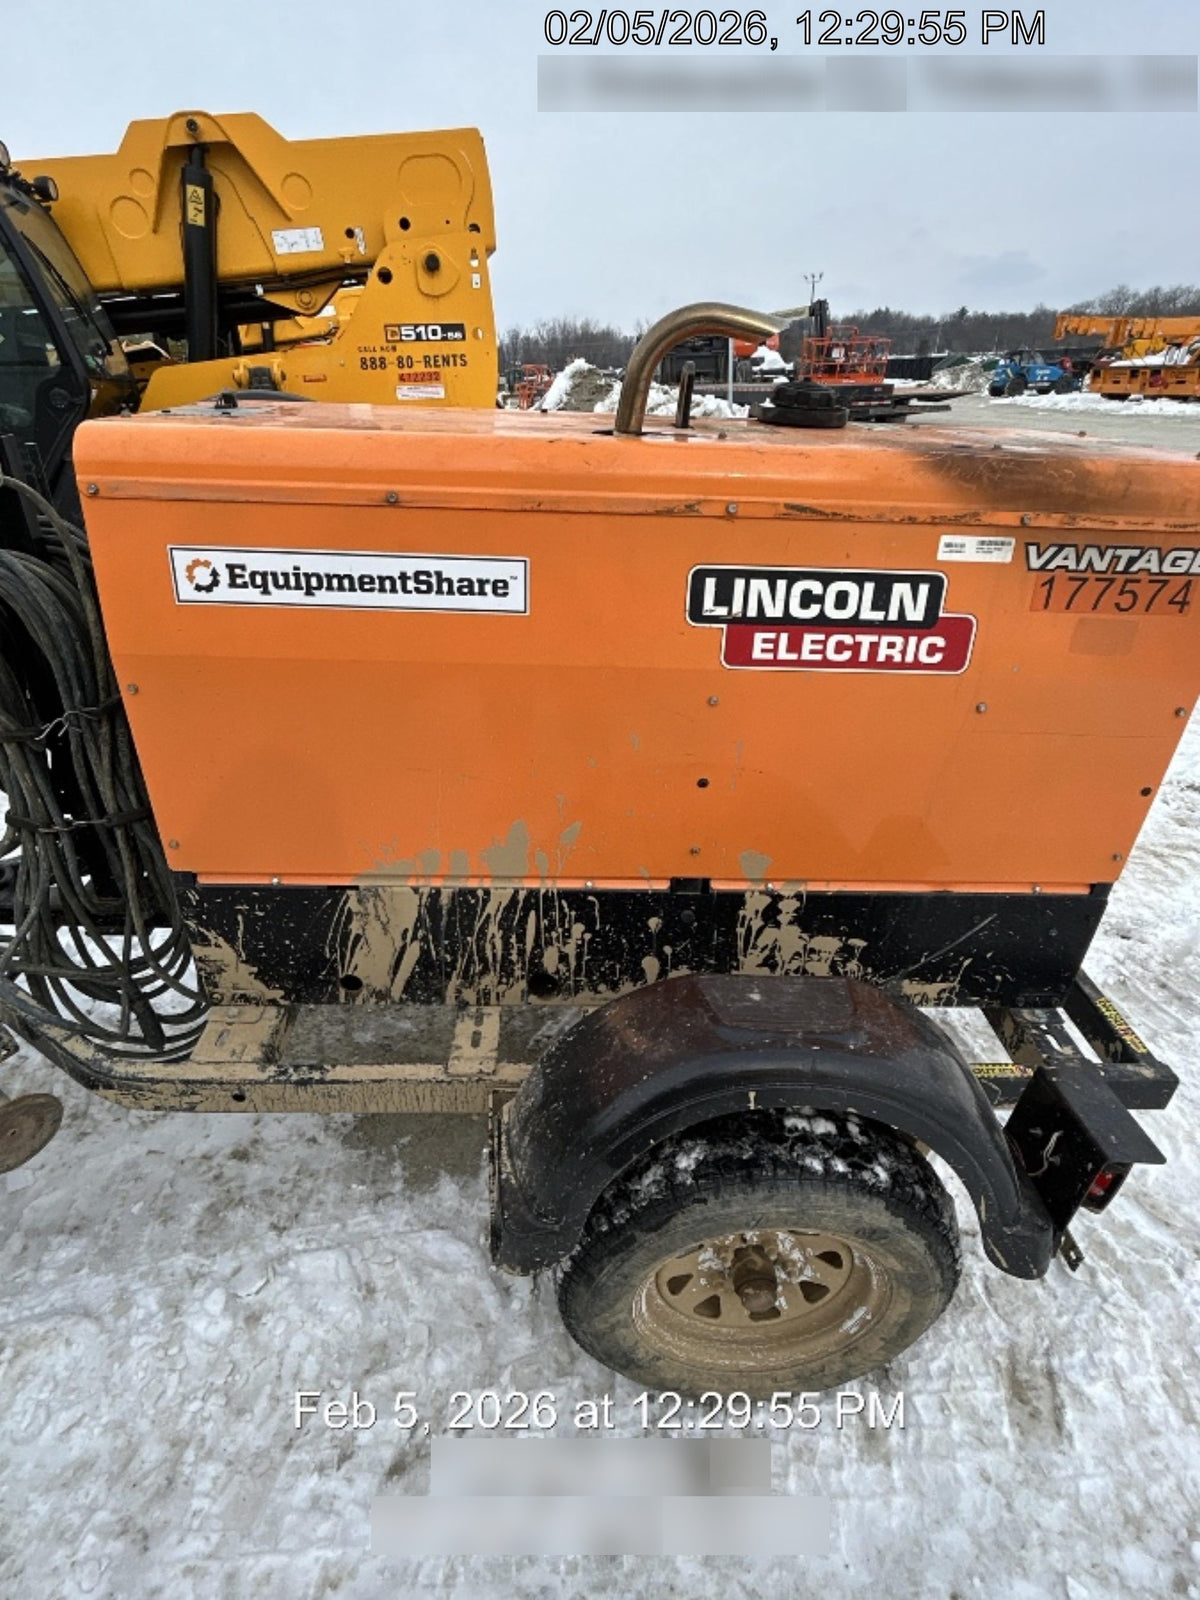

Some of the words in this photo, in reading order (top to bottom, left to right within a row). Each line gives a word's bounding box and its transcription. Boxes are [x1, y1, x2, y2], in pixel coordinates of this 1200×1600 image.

[360, 353, 468, 371] 888-80-RENTS
[702, 577, 930, 622] LINCOLN
[1040, 577, 1193, 614] 177574
[752, 632, 947, 665] ELECTRIC
